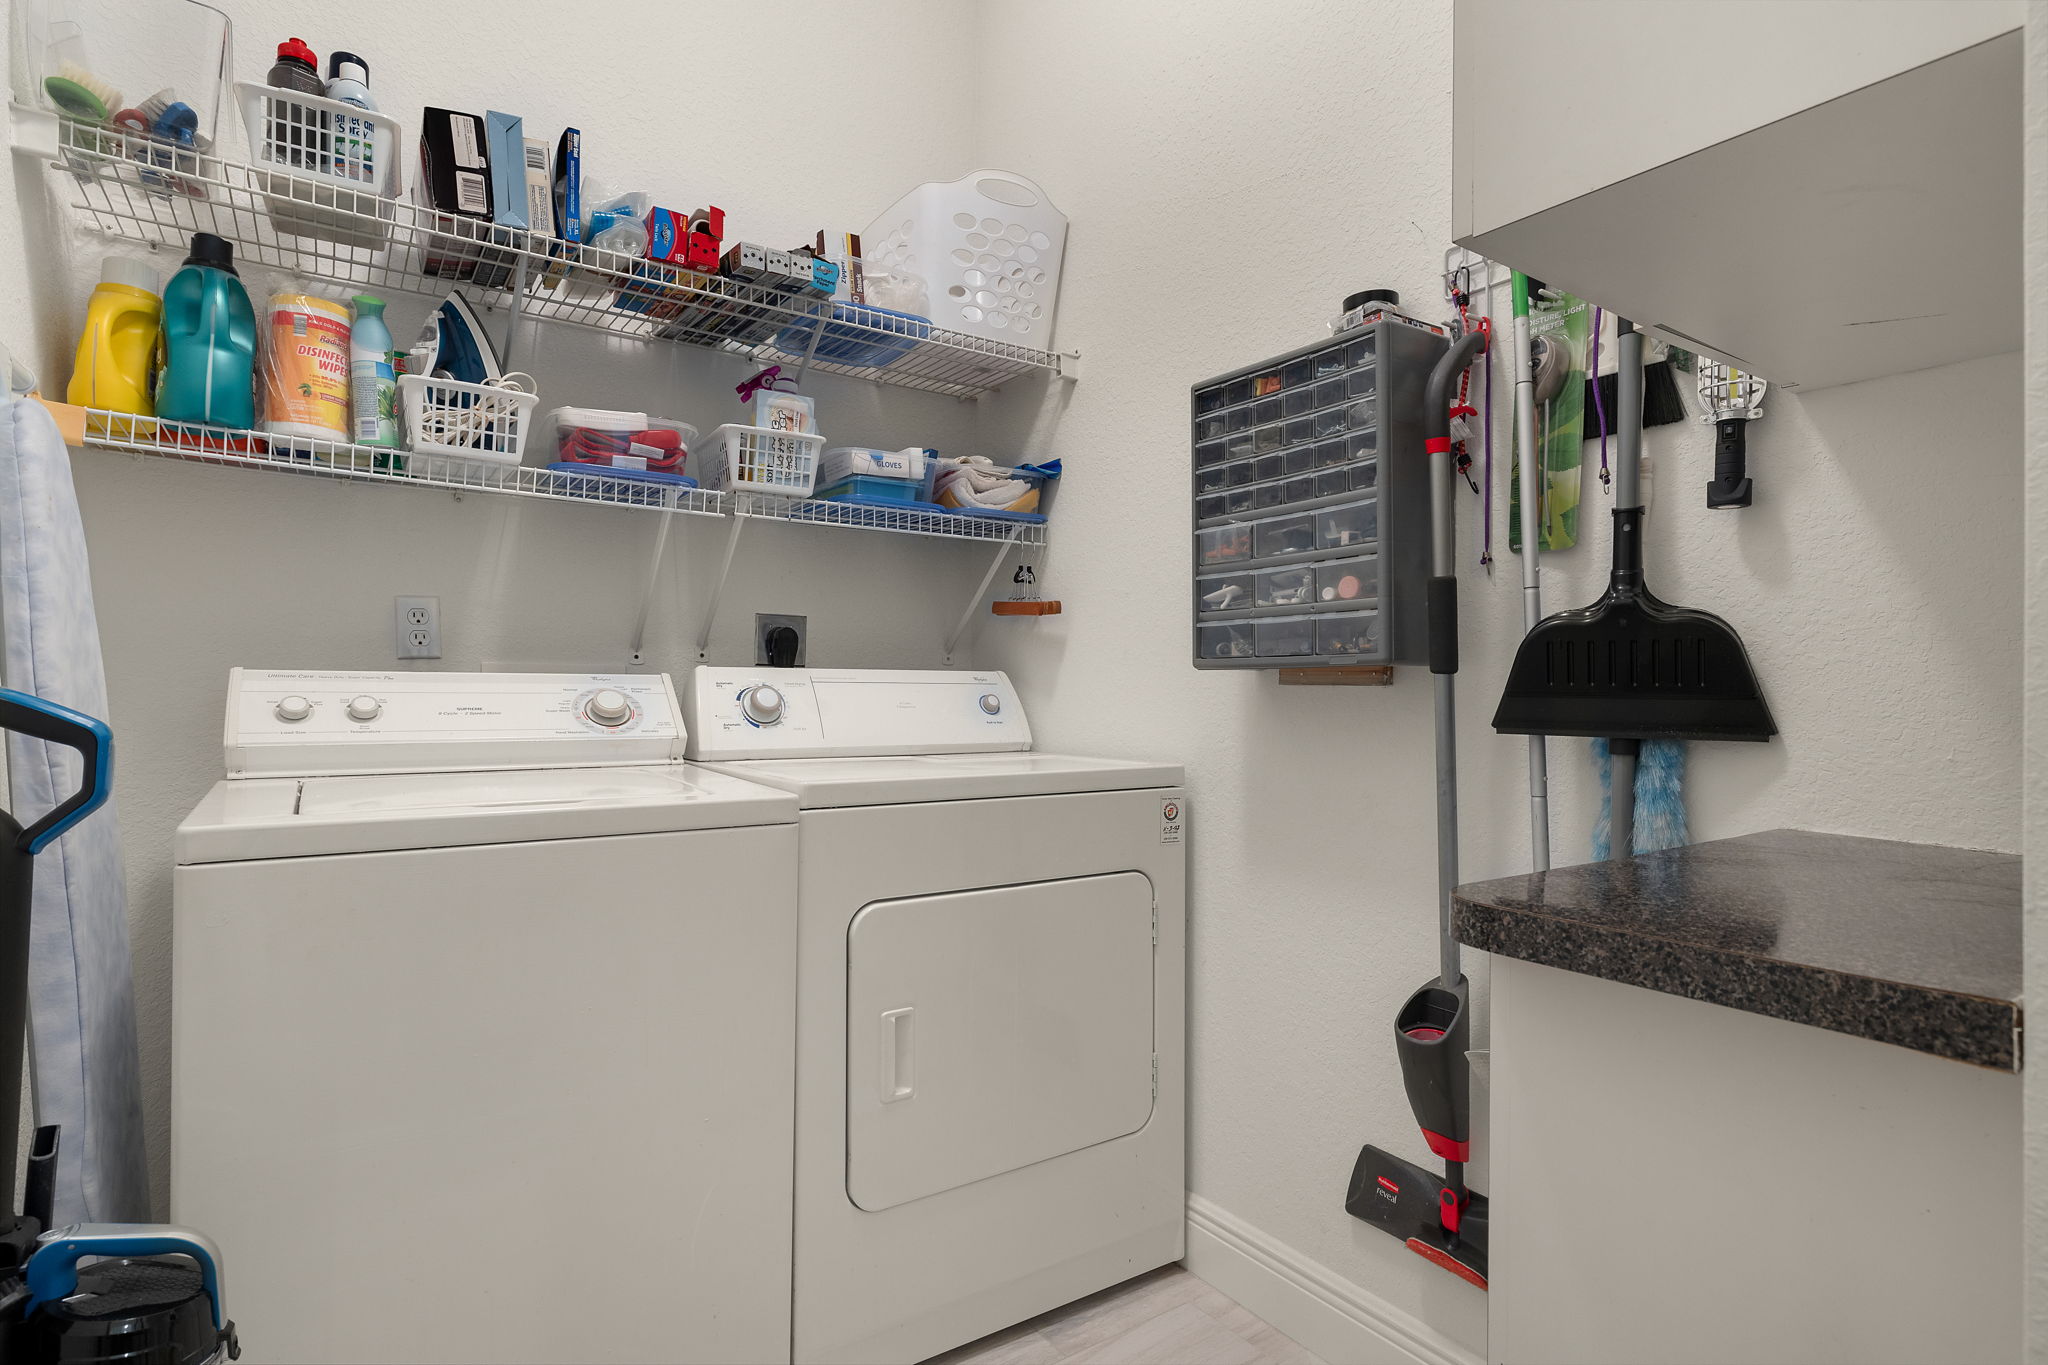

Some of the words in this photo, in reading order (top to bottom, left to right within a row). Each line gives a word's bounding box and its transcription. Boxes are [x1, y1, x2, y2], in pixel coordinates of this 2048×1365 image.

[855, 273, 863, 293] Snack
[1563, 303, 1585, 317] LIGHT
[1540, 319, 1565, 332] METER
[318, 359, 349, 377] WIPES
[876, 460, 902, 469] GLOVES
[1376, 1187, 1397, 1204] reveal
